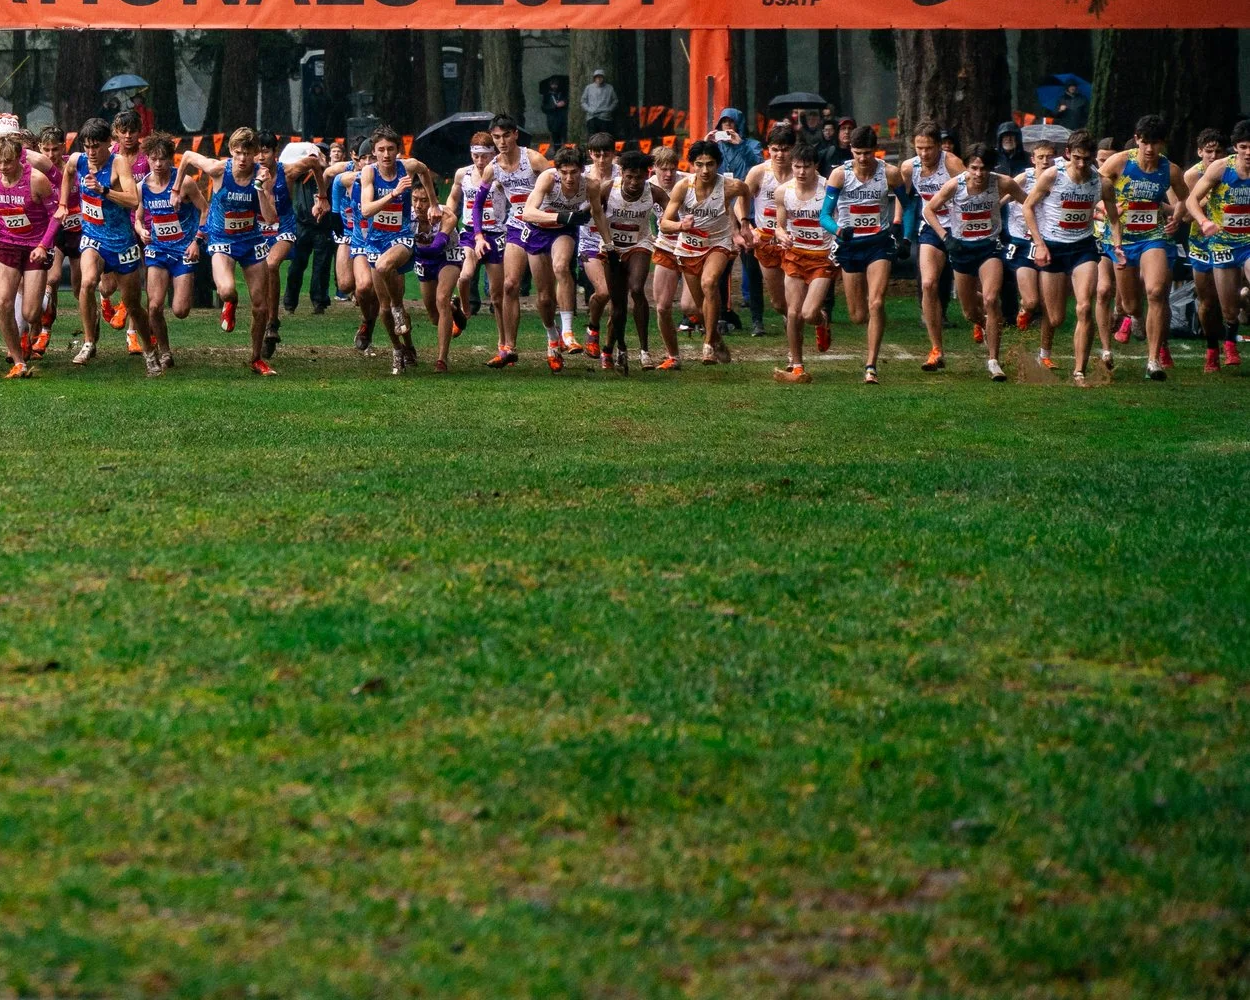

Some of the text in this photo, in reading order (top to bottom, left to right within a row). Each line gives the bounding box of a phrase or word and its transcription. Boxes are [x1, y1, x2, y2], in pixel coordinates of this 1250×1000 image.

[11, 195, 25, 204] PARK
[227, 192, 252, 202] CARROLL
[961, 201, 994, 212] SOUTHEAST
[85, 206, 99, 218] 314
[613, 208, 647, 219] HEARTLAND
[378, 215, 398, 224] 315
[1065, 213, 1087, 222] 390
[1131, 214, 1153, 223] 249
[7, 219, 25, 227] 227
[854, 218, 877, 227] 392
[967, 222, 988, 231] 393
[1228, 218, 1250, 227] 248
[159, 226, 178, 236] 320
[798, 230, 819, 239] 363
[613, 232, 633, 242] 201
[685, 236, 703, 248] 361
